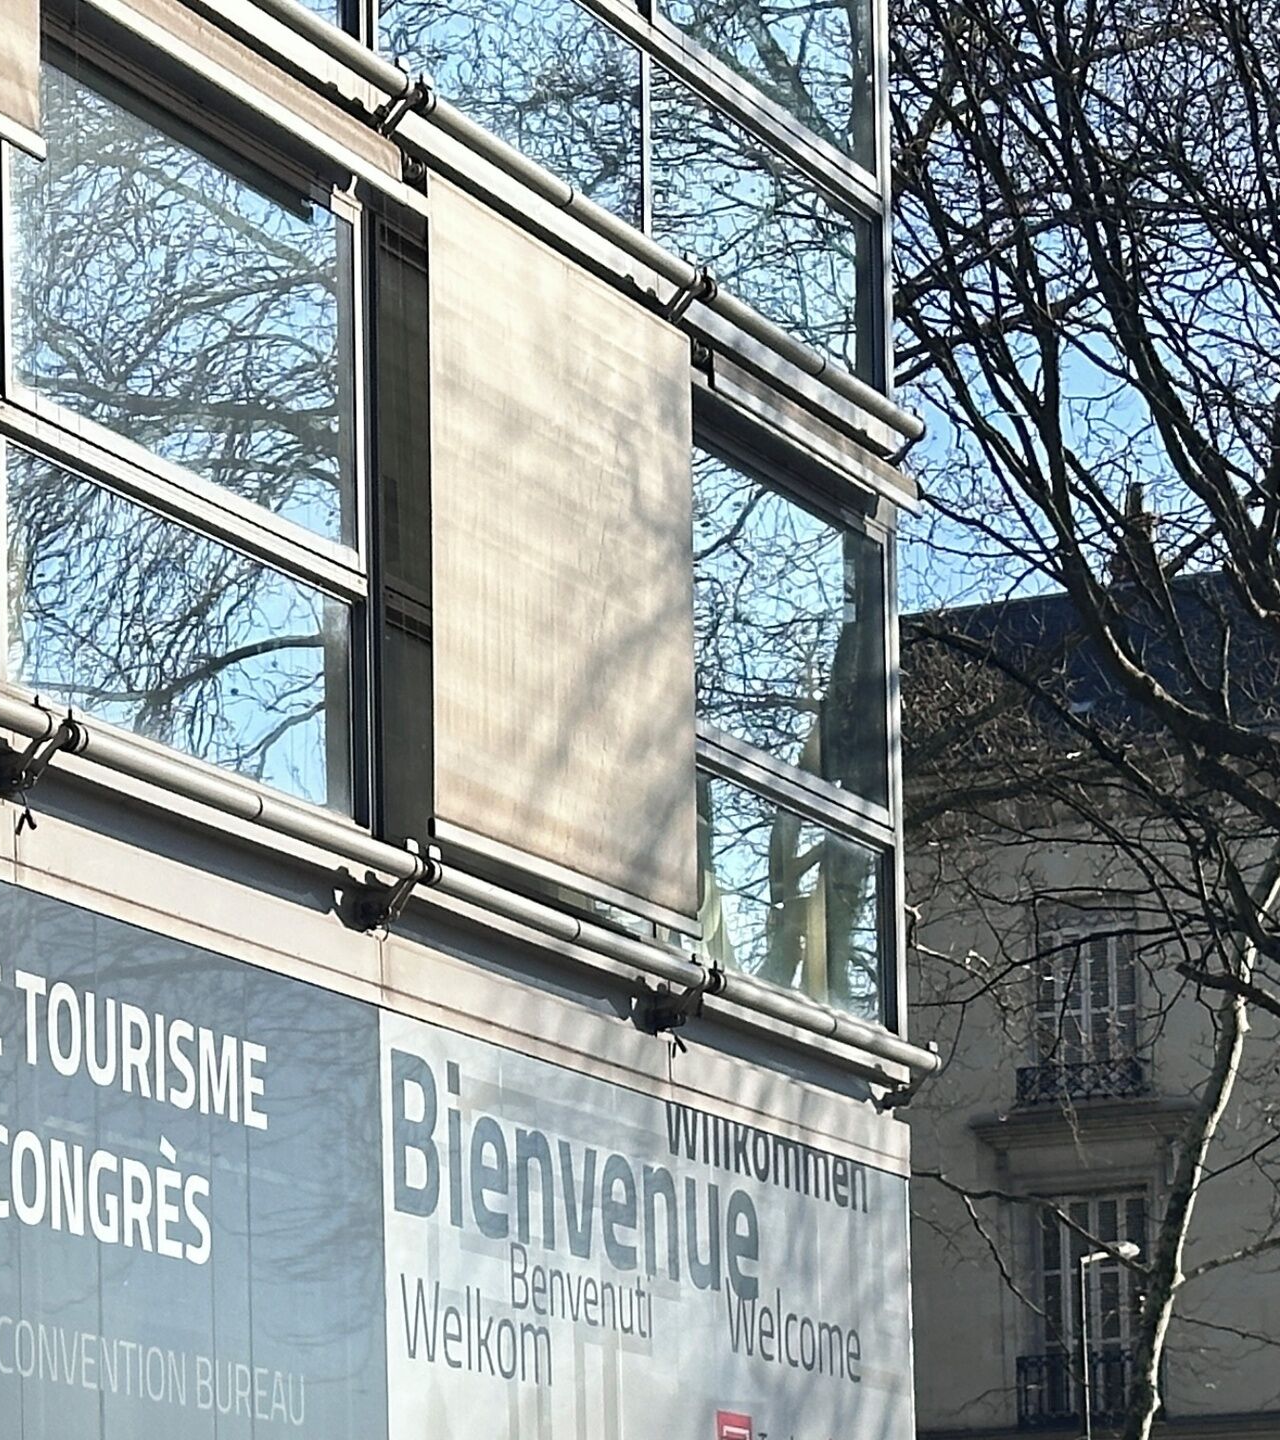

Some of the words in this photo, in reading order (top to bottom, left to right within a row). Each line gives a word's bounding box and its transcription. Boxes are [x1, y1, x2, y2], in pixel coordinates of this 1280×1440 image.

[15, 970, 268, 1131] TOURISME
[391, 1048, 760, 1300] Bienvenue
[400, 1273, 553, 1386] Welkom
[509, 1242, 653, 1338] Benvenuti
[725, 1277, 862, 1383] Welcome
[196, 1356, 305, 1426] BUREAU
